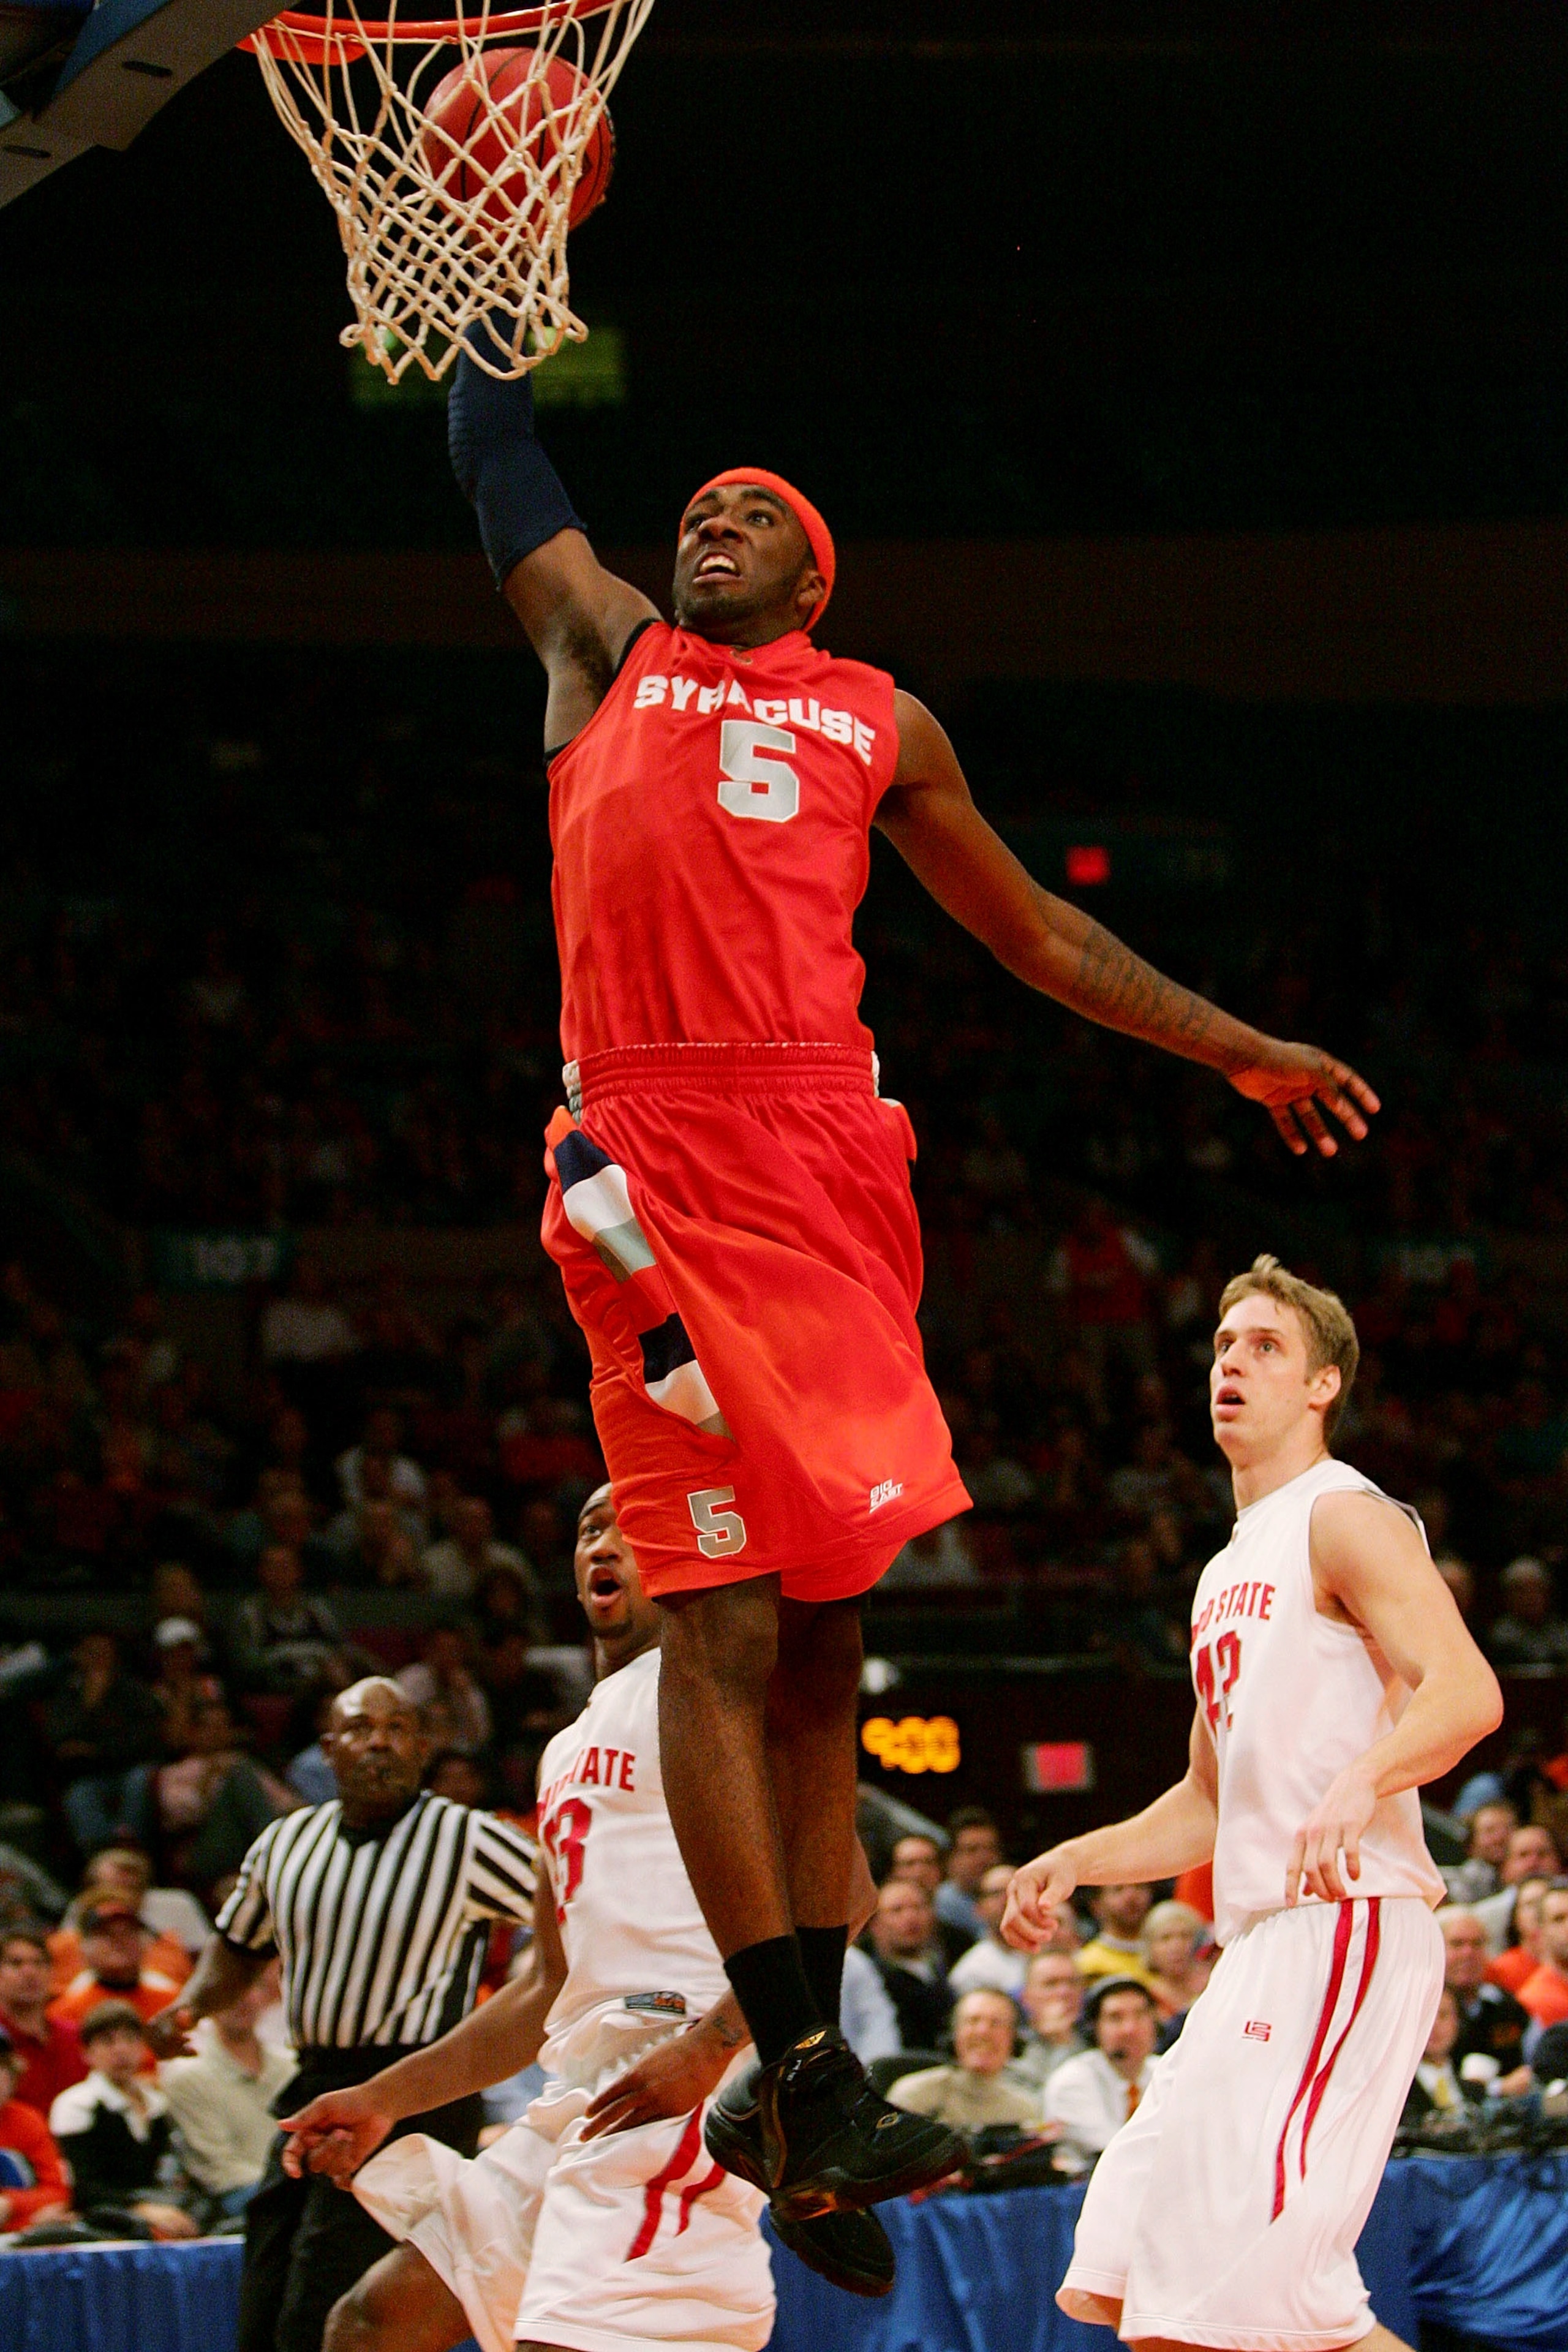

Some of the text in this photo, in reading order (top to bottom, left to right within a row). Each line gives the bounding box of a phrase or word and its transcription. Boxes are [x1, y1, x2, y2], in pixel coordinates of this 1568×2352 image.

[633, 674, 876, 766] SYRACUSE
[717, 718, 800, 823] 5
[686, 1485, 747, 1559] 5
[870, 1482, 903, 1509] EAST
[1215, 1581, 1276, 1623] STATE
